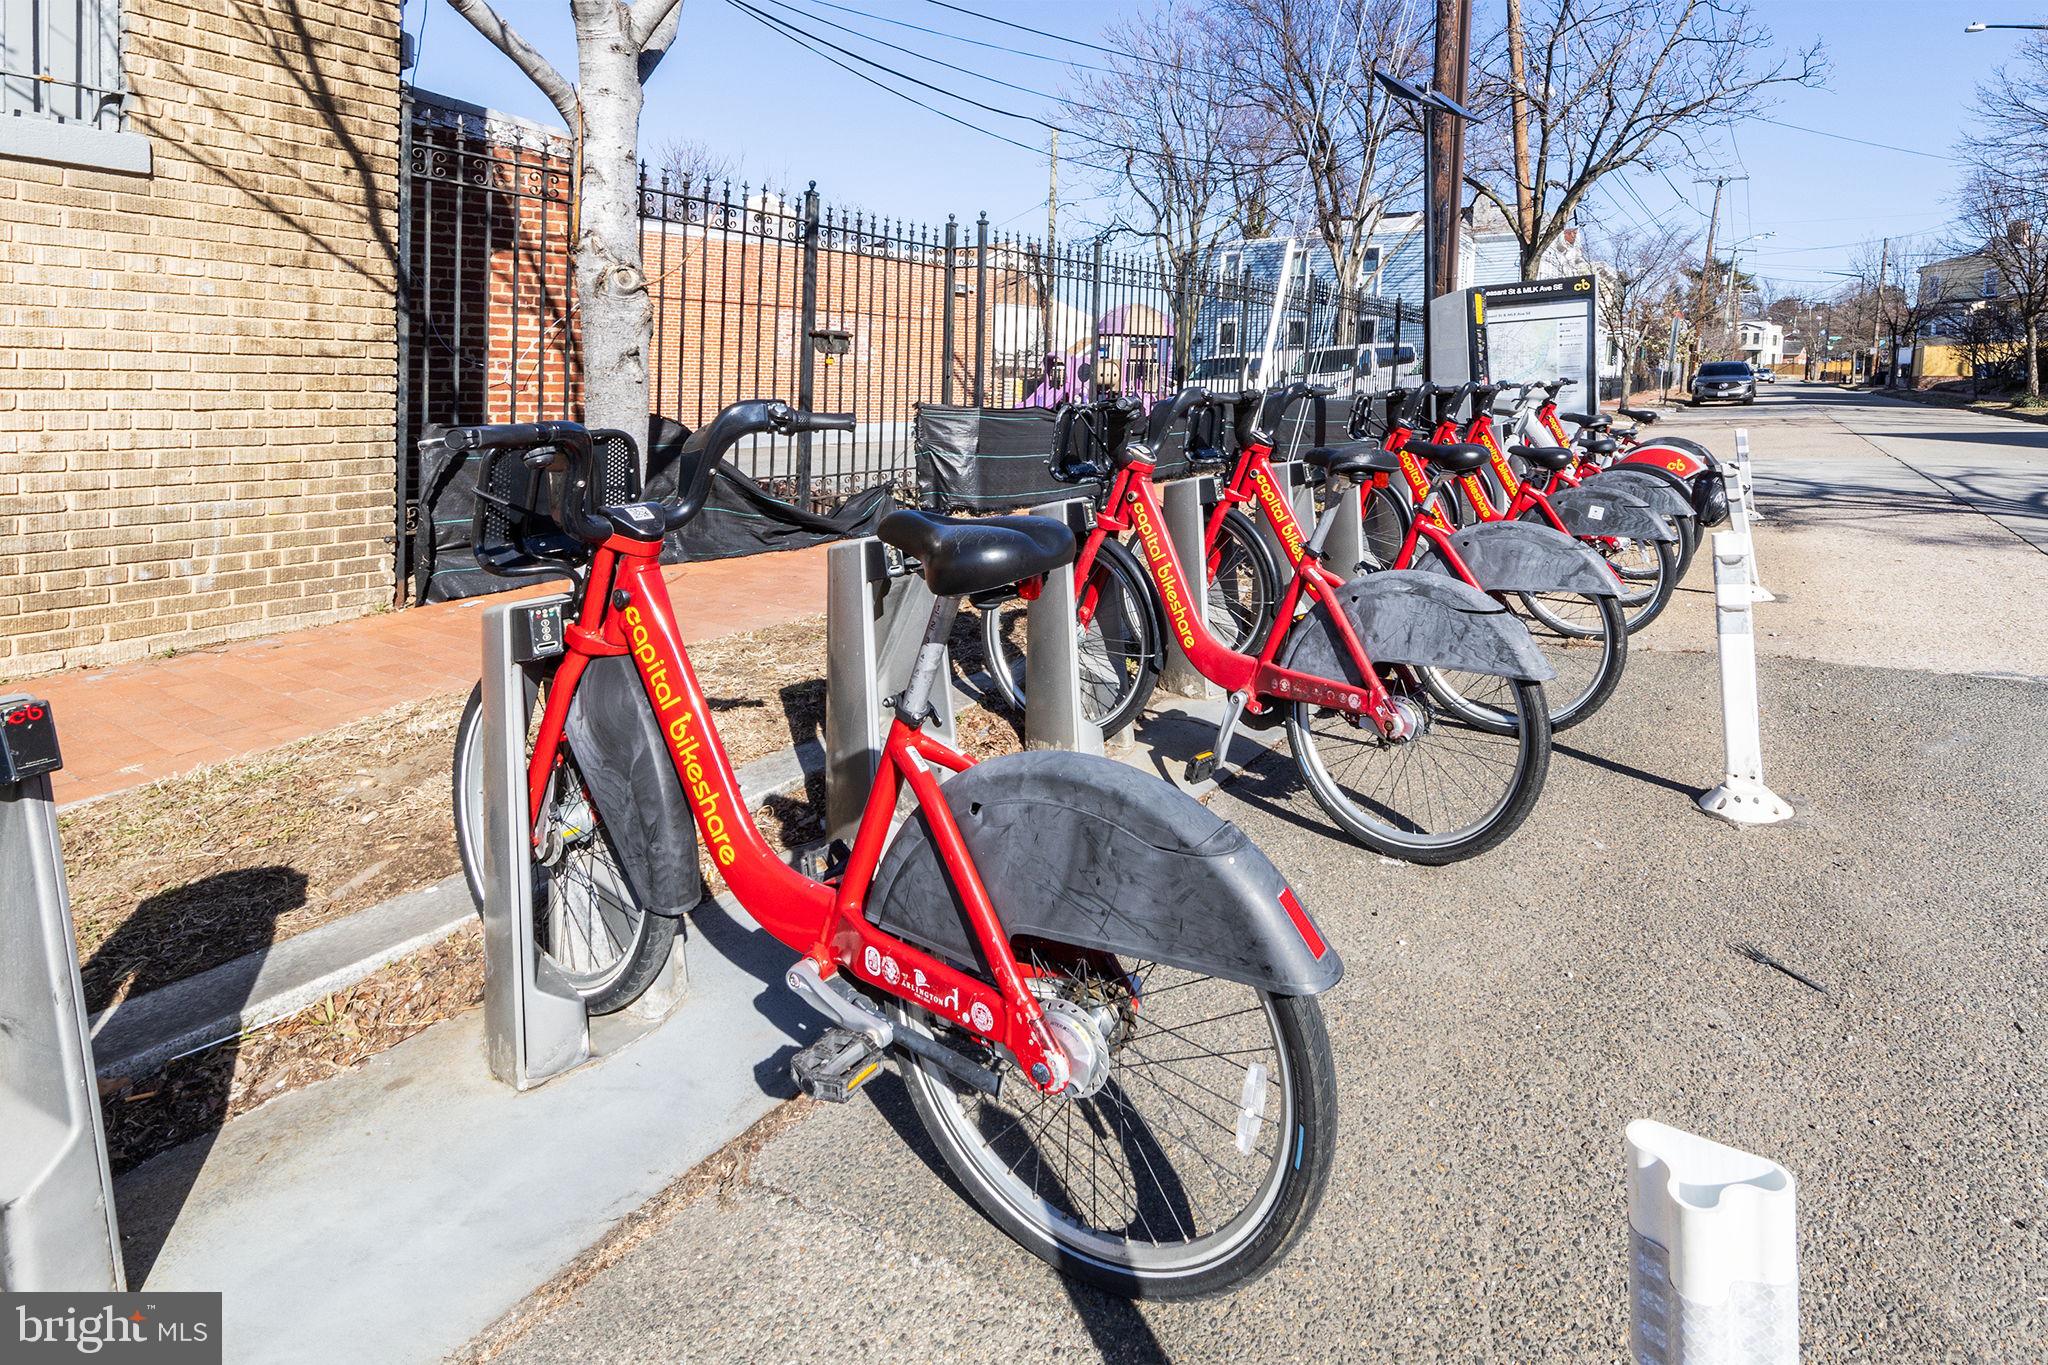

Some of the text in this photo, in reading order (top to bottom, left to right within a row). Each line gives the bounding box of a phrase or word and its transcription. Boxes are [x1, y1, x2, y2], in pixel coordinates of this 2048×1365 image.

[1486, 289, 1507, 297] easant
[1516, 287, 1522, 295] &
[1523, 286, 1539, 294] MLK
[1553, 283, 1563, 291] SE
[1399, 450, 1425, 486] capital
[1497, 461, 1519, 496] bikesha
[1256, 474, 1304, 562] capital bikes
[1133, 502, 1195, 648] capital bikeshare
[625, 605, 736, 866] capital bikeshare
[901, 979, 944, 1007] ARLINGTON
